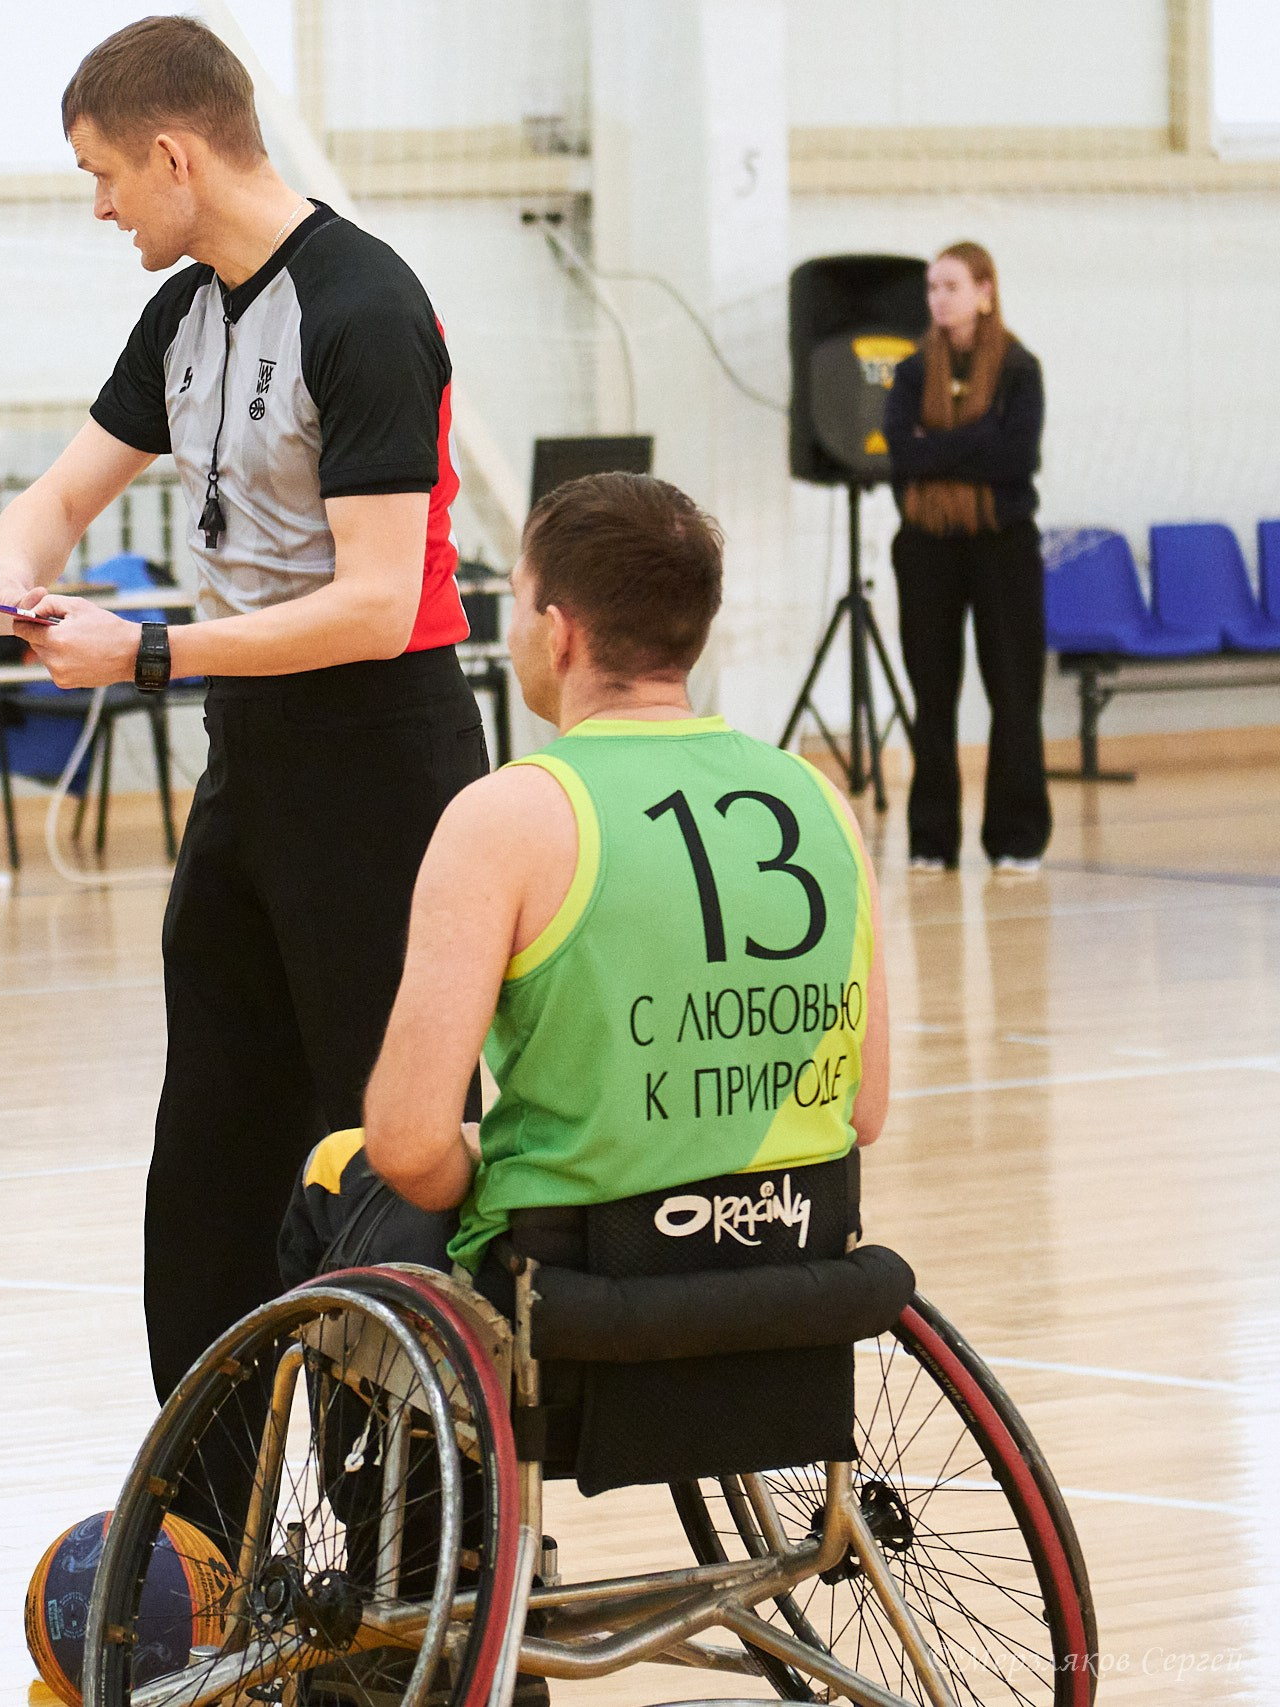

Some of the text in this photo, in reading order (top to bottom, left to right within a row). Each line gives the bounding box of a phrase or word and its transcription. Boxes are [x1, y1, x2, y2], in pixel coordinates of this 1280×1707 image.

[644, 790, 827, 963] 13
[630, 981, 862, 1046] С ЛЮБОВЬЮ
[646, 1055, 847, 1121] К ПРИРОДЕ
